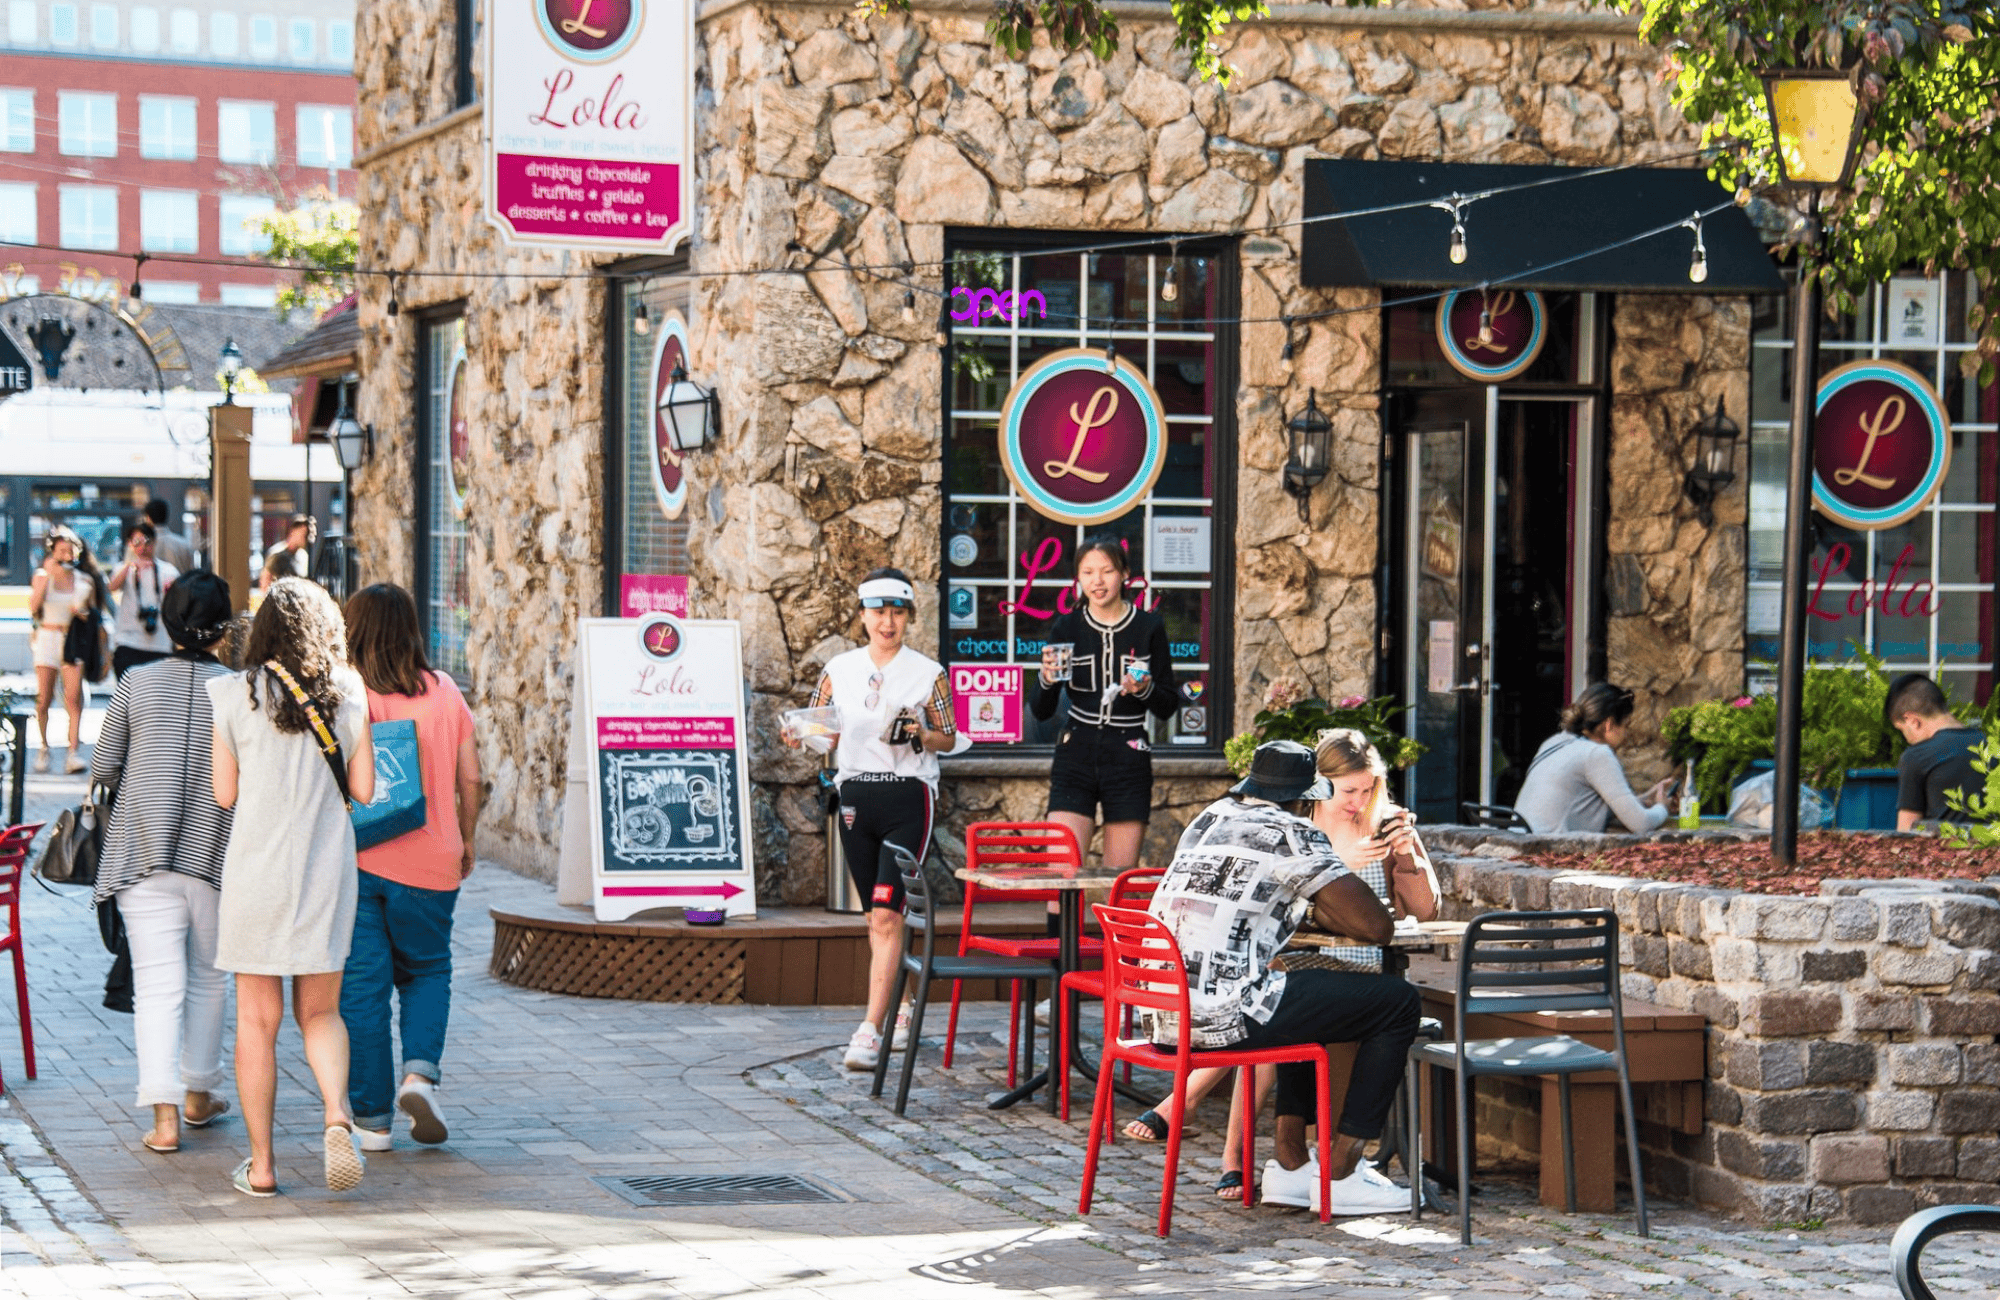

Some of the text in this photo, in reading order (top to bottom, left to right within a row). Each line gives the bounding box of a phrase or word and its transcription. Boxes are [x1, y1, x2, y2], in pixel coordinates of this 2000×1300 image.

[528, 67, 648, 130] Lola
[525, 161, 651, 185] drinking chocolate
[531, 182, 644, 208] truffles gelato
[508, 203, 669, 227] desserts coffee tea
[950, 286, 1047, 327] open
[1043, 385, 1119, 483] L
[1834, 394, 1907, 490] L
[1806, 541, 1945, 622] Lola
[651, 625, 671, 652] L
[956, 636, 1009, 657] choco
[1169, 642, 1200, 658] use
[630, 664, 697, 696] Lola
[955, 669, 1018, 692] DOH!
